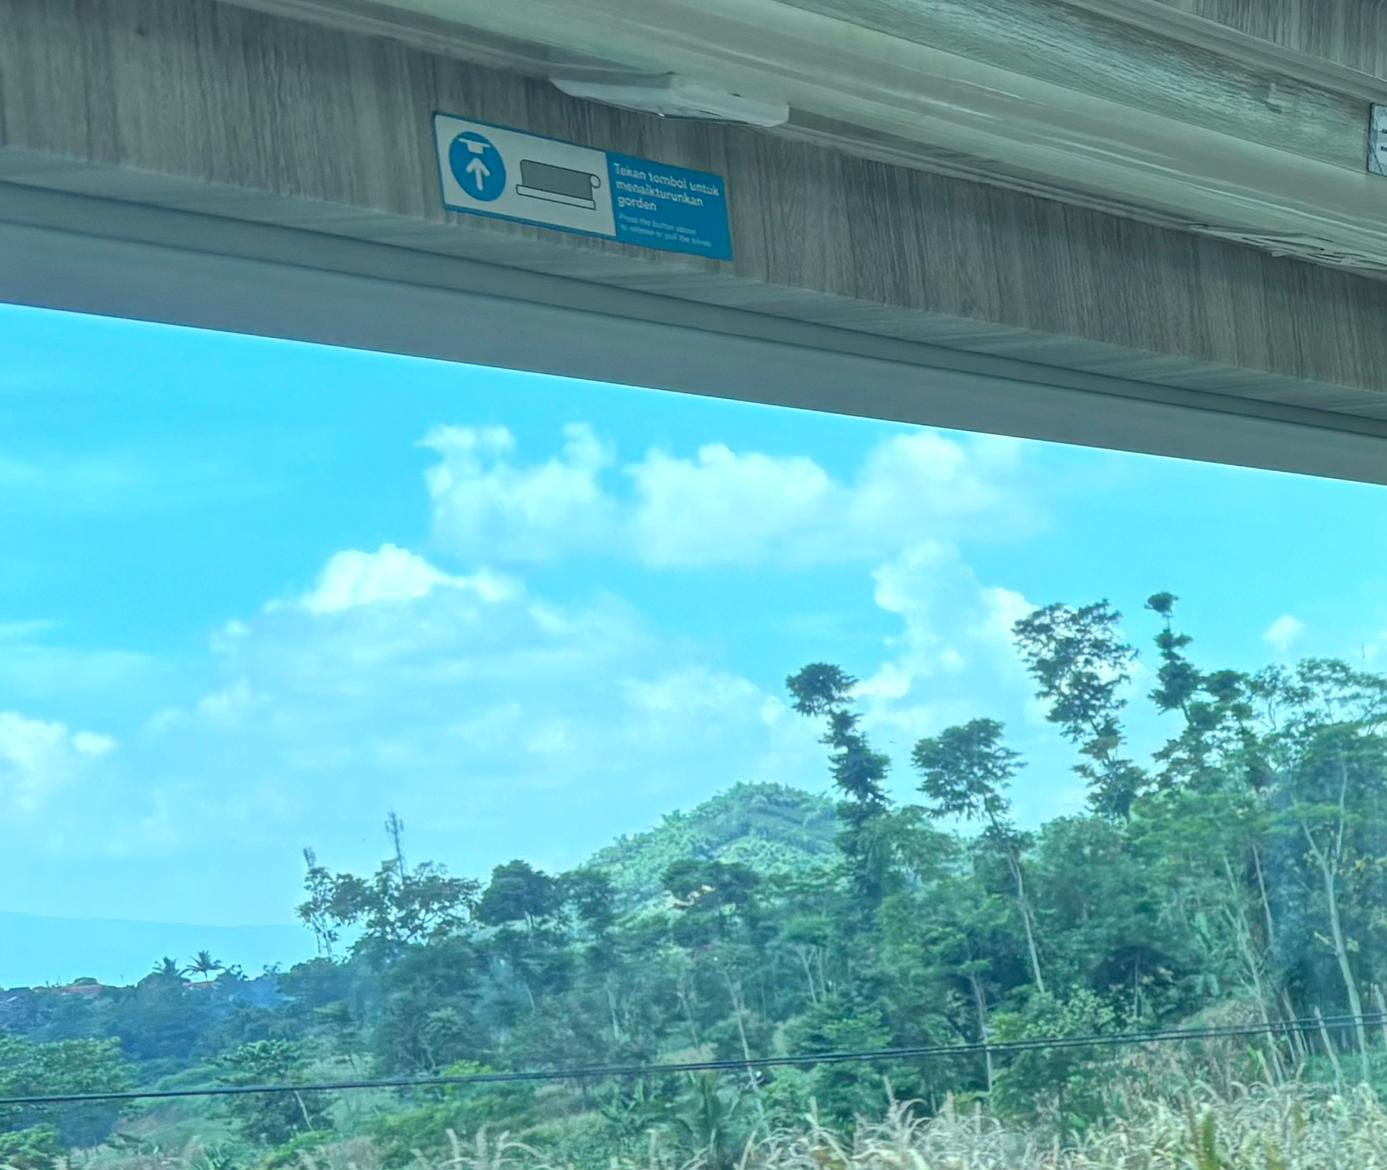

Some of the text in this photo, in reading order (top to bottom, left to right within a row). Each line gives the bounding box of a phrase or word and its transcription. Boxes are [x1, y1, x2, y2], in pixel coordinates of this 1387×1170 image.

[613, 162, 720, 197] Tekan tombol untuk
[617, 196, 657, 211] gorden
